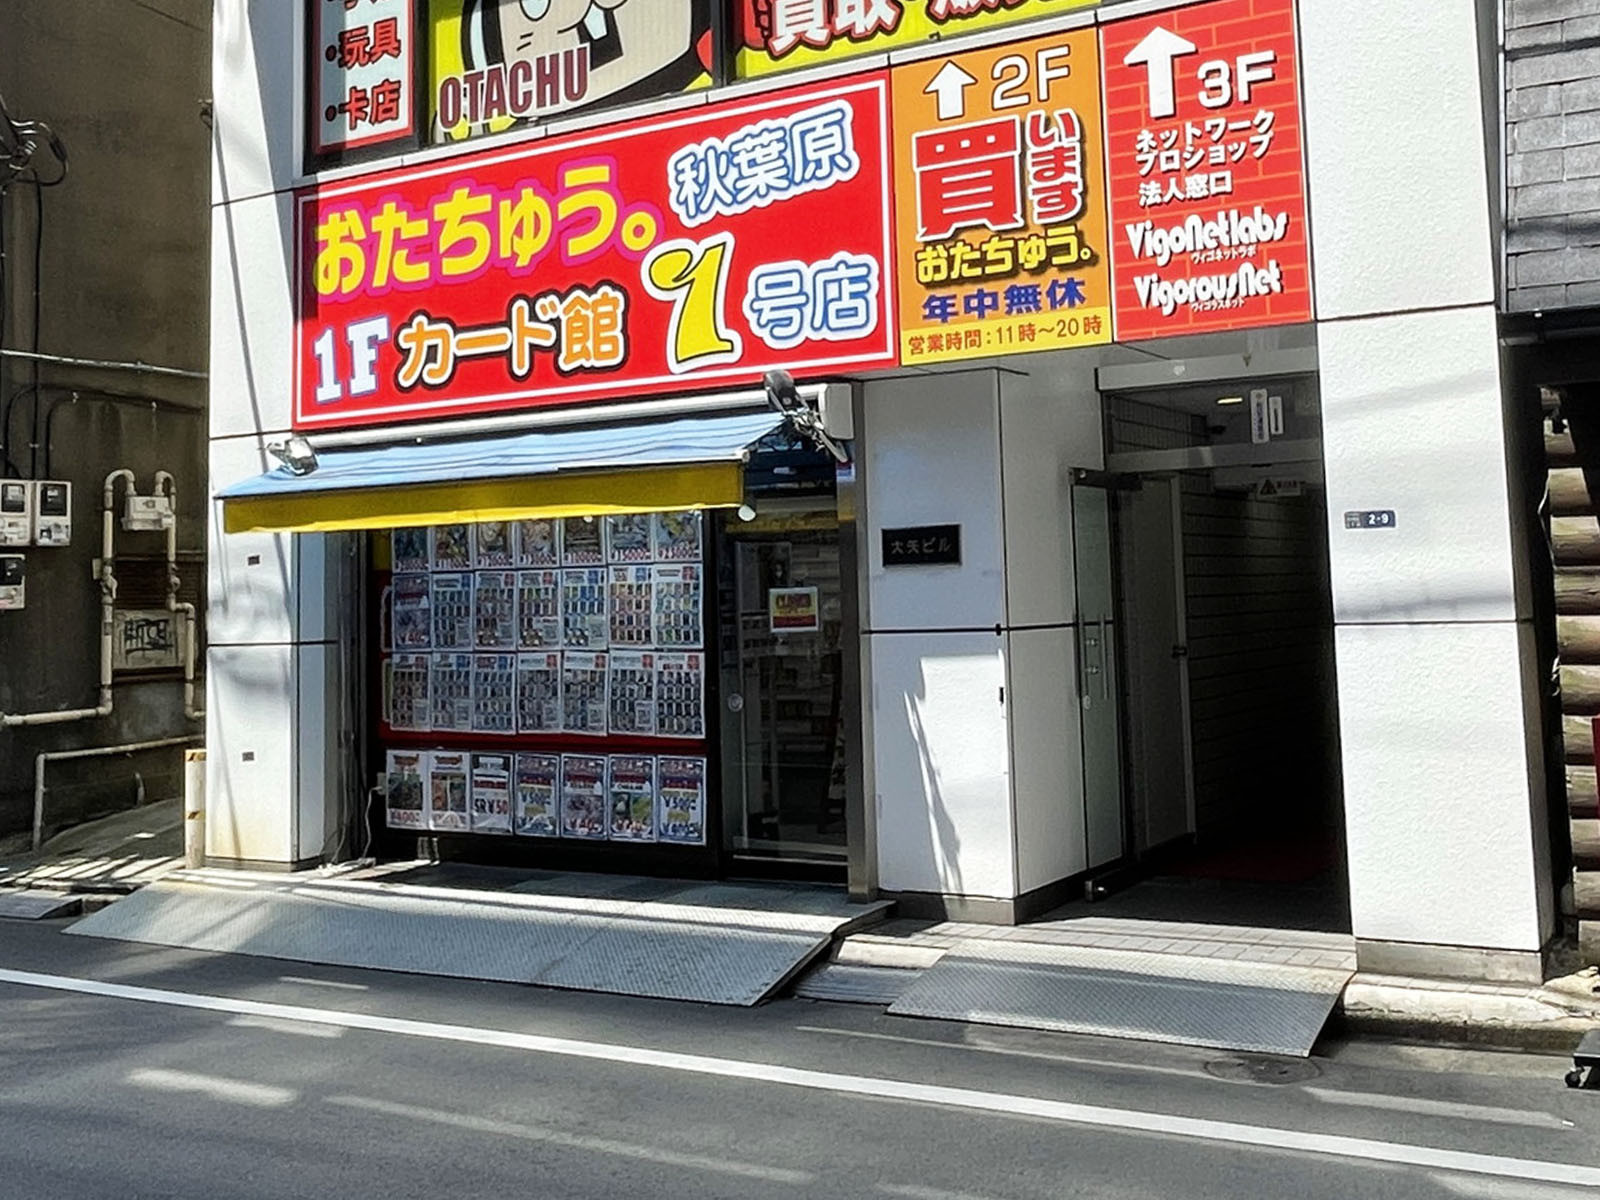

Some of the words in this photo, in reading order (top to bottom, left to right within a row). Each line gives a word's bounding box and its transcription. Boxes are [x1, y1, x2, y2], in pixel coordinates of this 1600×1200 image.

[338, 16, 402, 70] 玩具
[342, 79, 402, 130] 卡店
[439, 47, 589, 127] OTACHU
[991, 44, 1071, 111] 2F
[1197, 50, 1275, 108] 3F
[1135, 109, 1275, 151] ネットワーク
[1135, 130, 1275, 177] プロショップ
[671, 104, 855, 223] 秋葉原
[1138, 170, 1234, 207] 法人窓口
[314, 165, 657, 296] おたちゅう。
[915, 225, 1092, 283] おたちゅう。
[922, 277, 1087, 324] 年中無休
[314, 316, 390, 405] 1F
[398, 287, 624, 386] カード館
